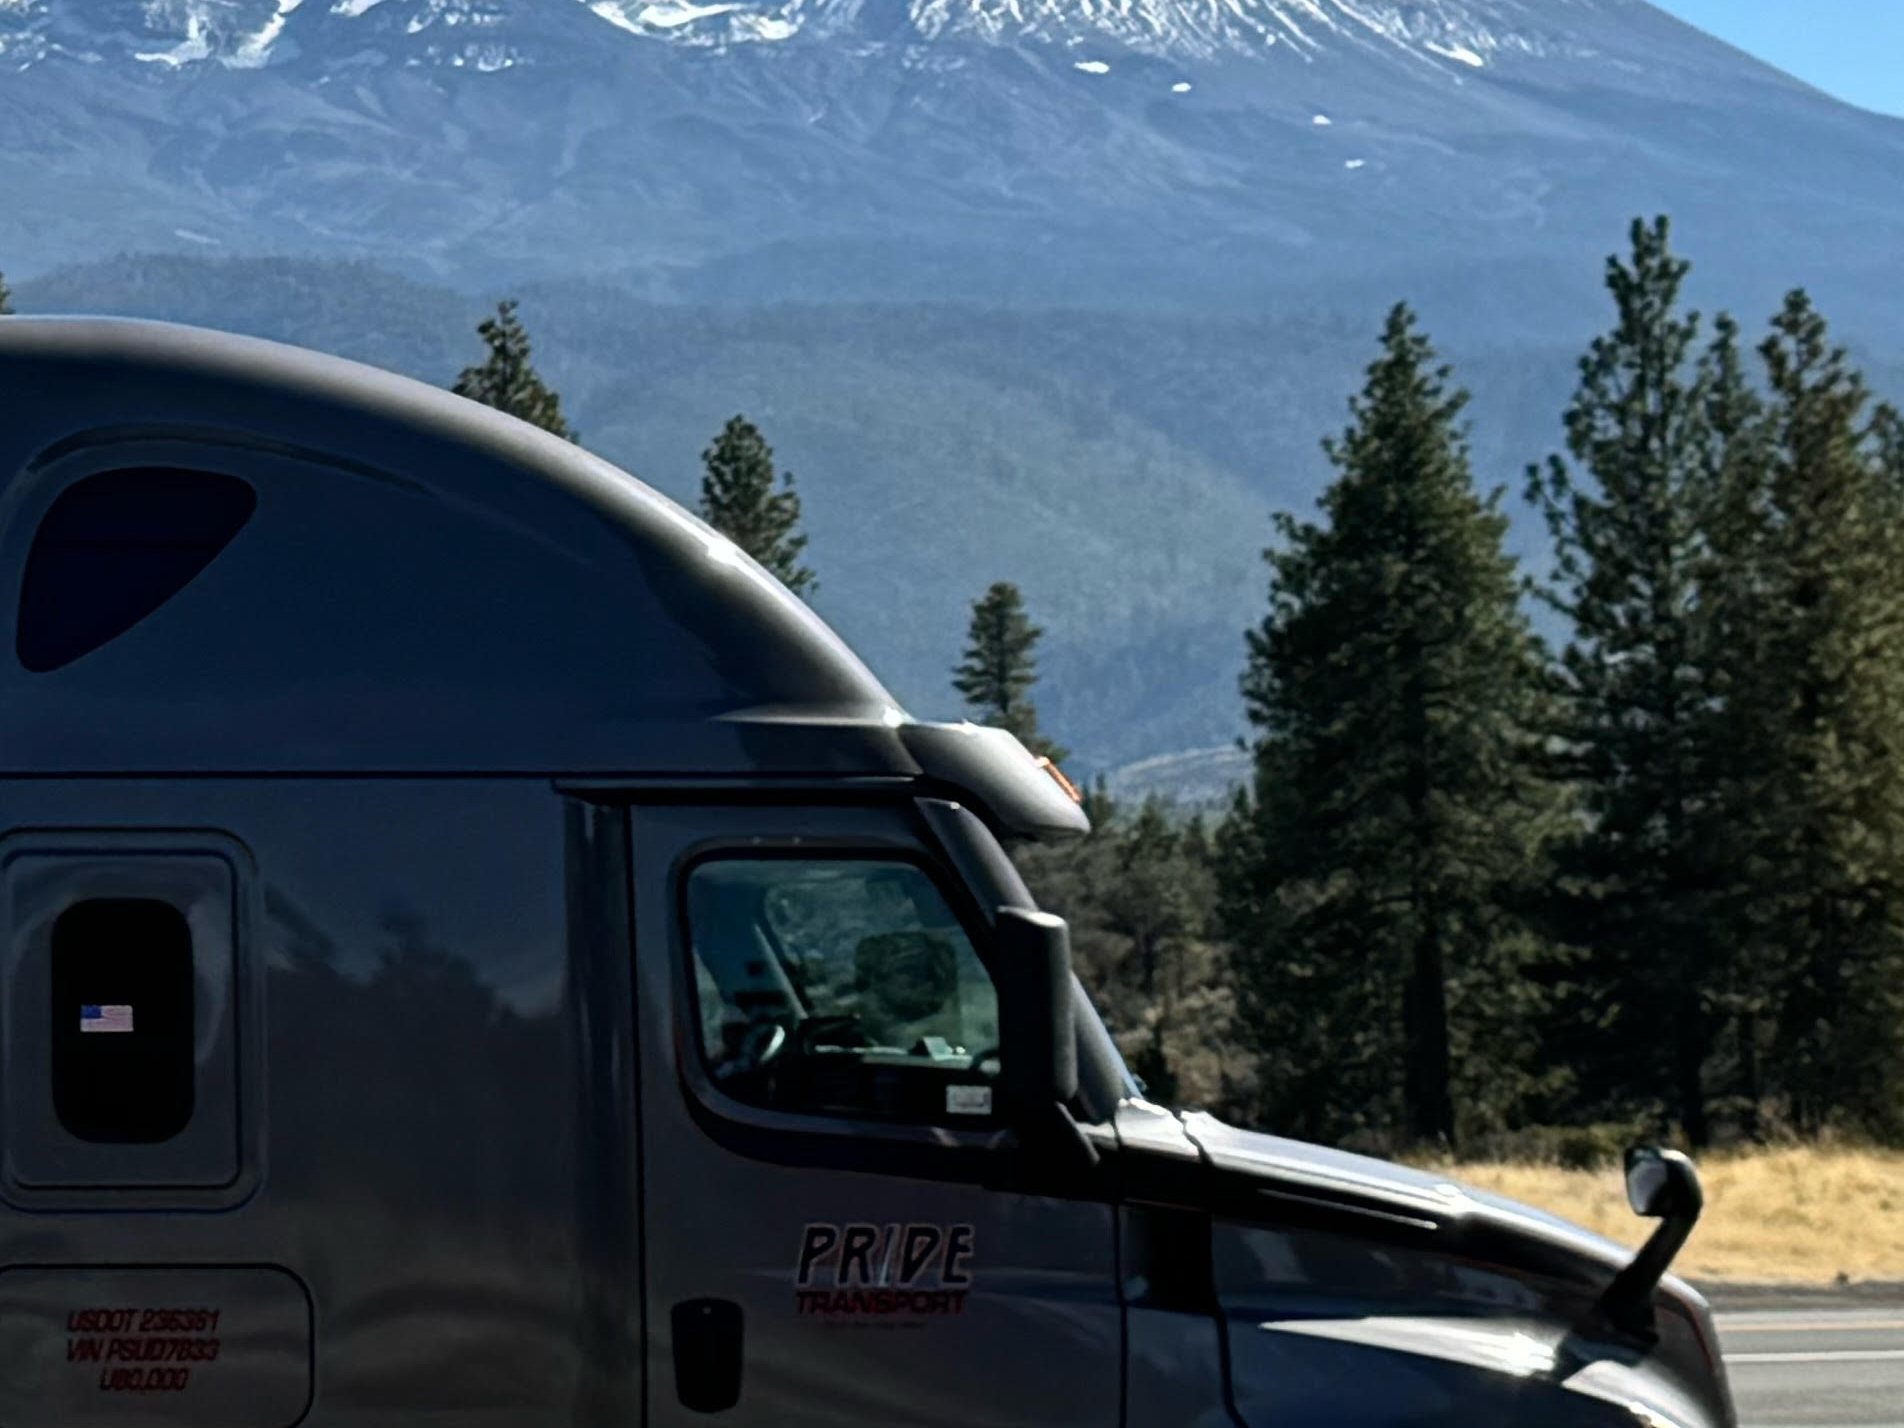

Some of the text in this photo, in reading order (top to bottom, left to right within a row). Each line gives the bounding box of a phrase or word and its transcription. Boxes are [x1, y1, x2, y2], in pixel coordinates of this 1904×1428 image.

[795, 1222, 976, 1289] PRIDE
[796, 1290, 969, 1315] TRANSPORT
[68, 1309, 137, 1331] USDOT
[68, 1338, 102, 1361] VIN
